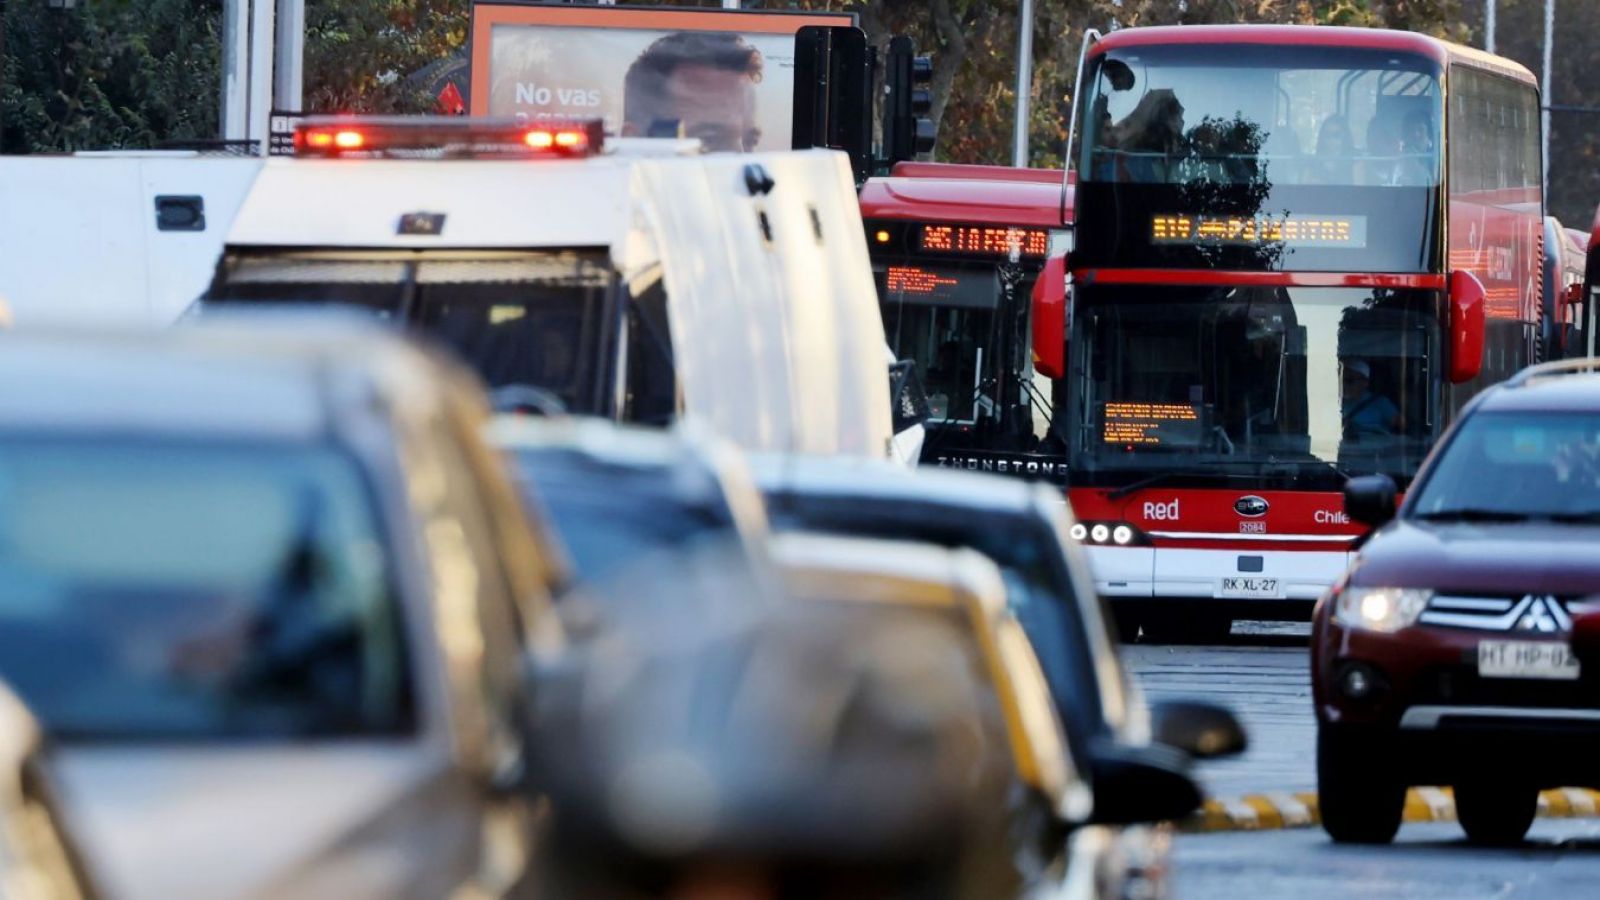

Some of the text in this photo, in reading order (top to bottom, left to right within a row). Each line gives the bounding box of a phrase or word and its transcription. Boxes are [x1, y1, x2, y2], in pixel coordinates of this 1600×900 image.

[515, 82, 601, 107] No vas
[937, 456, 1068, 476] ZHONGTONG
[1143, 497, 1179, 520] Red
[1314, 510, 1351, 525] Chile
